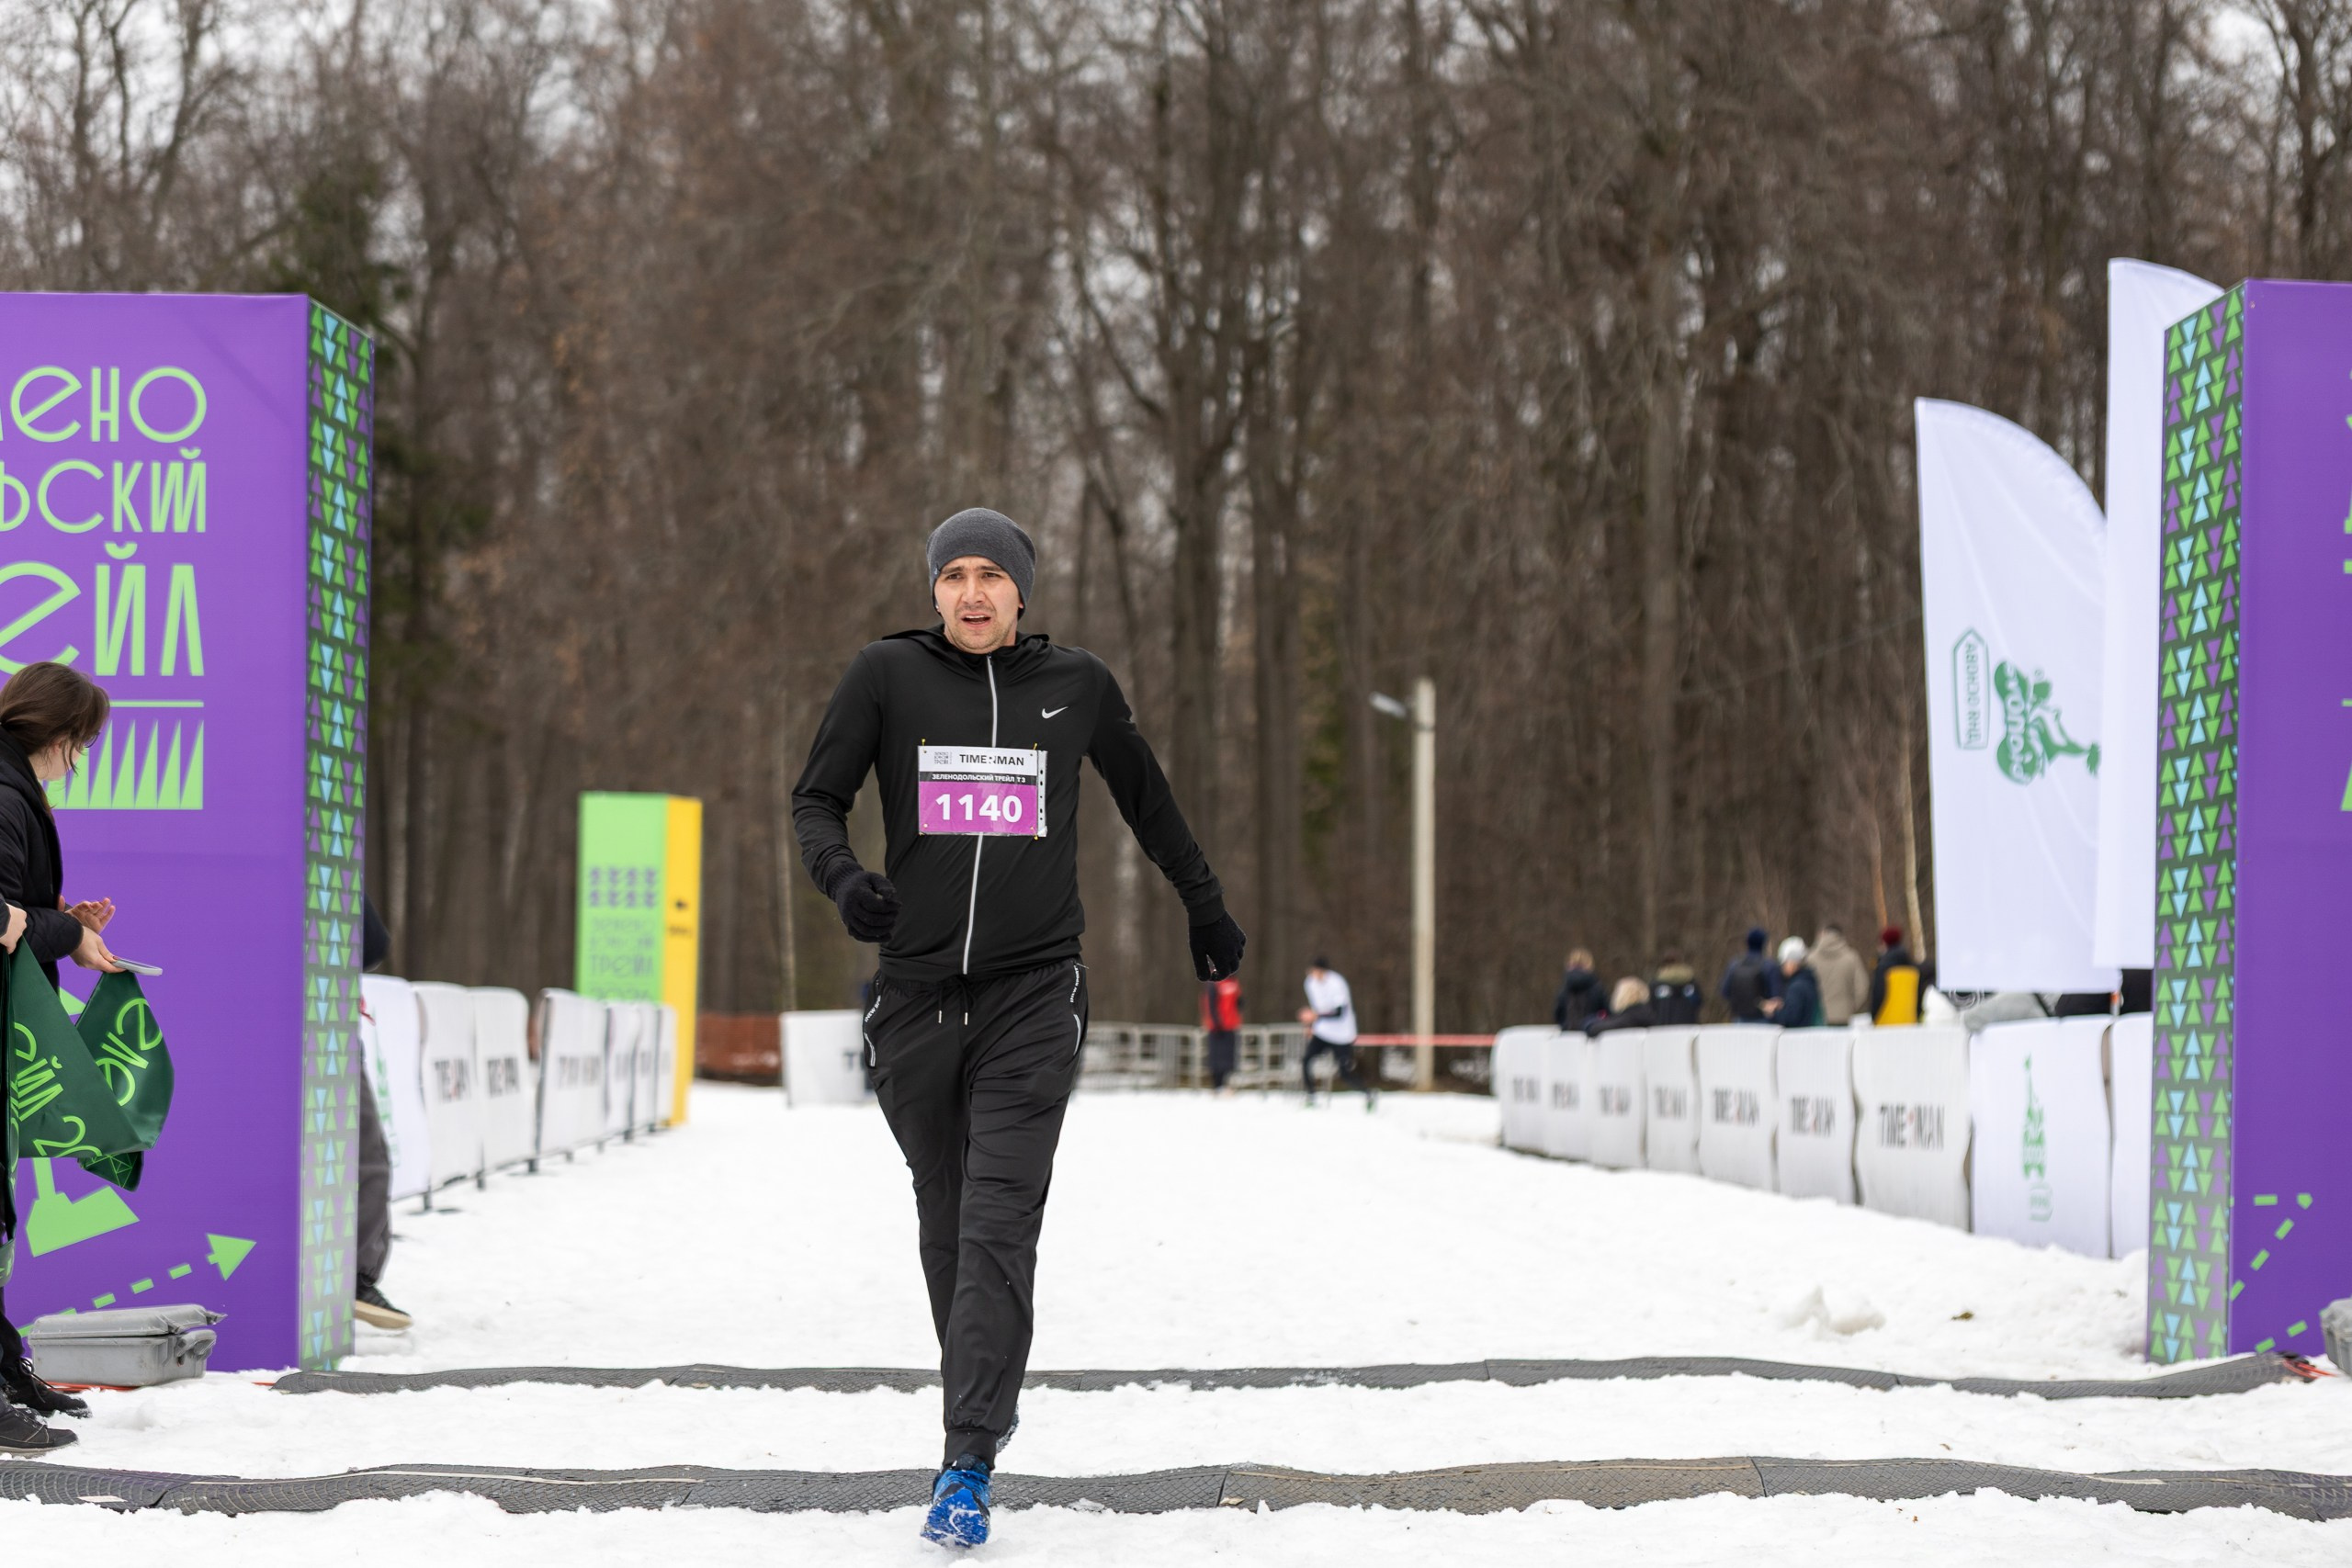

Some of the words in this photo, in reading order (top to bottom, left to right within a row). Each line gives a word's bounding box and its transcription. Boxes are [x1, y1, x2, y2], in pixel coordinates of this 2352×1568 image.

[0, 366, 207, 443] ЕНО
[932, 773, 994, 782] ЗЕЛЕНОДОЛЬСКИЙ
[994, 774, 1015, 783] ТРЕЙЛ
[935, 794, 1023, 823] 1140
